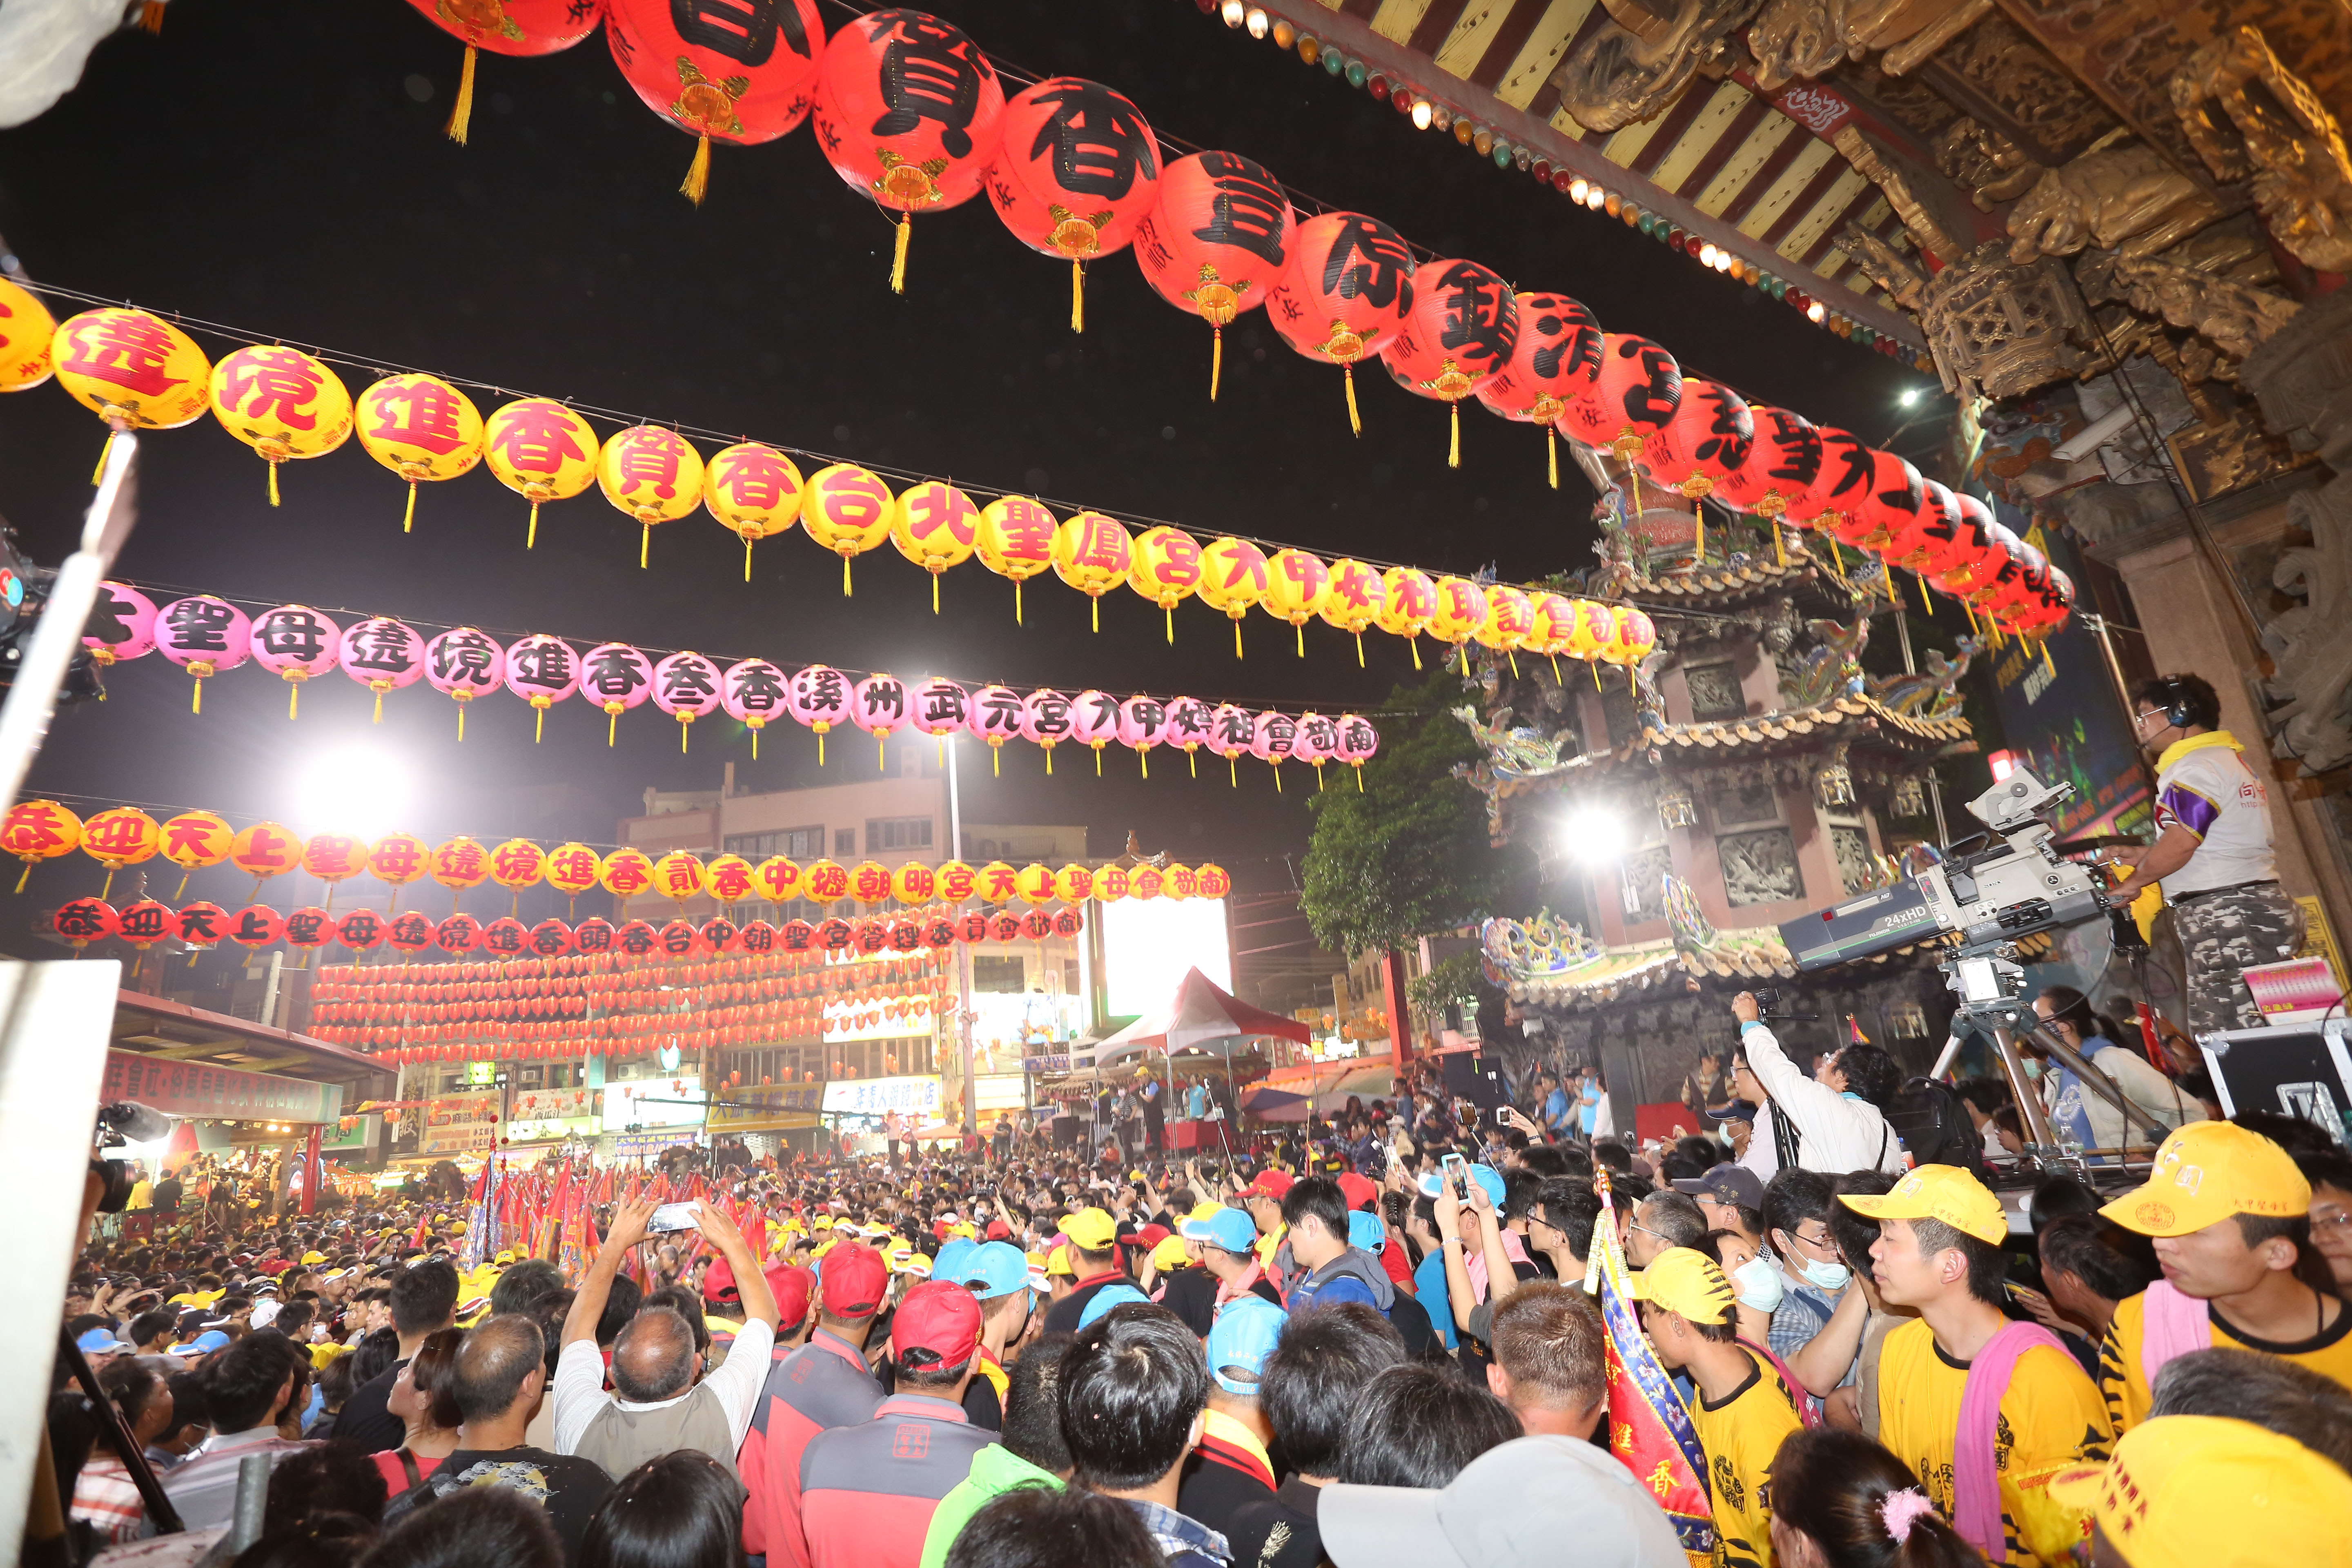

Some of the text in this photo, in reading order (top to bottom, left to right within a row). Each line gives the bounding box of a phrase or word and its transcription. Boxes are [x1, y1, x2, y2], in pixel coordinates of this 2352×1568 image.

[218, 347, 323, 430] 境
[369, 375, 467, 455] 進
[491, 402, 585, 474] 香
[717, 446, 797, 509] 香
[822, 469, 886, 528] 台
[911, 486, 976, 546] 北
[1000, 499, 1055, 561] 聖
[1072, 516, 1131, 572] 鳳
[1152, 531, 1201, 586] 宮
[1220, 545, 1268, 590] 大
[1283, 554, 1328, 603] 甲
[1393, 571, 1439, 618] 祖
[167, 600, 234, 650] 聖
[255, 611, 326, 661] 母
[434, 632, 492, 684] 境
[515, 640, 572, 688] 進
[588, 650, 646, 695] 香
[732, 665, 785, 710] 香
[799, 670, 842, 712] 溪
[865, 682, 902, 719] 州
[924, 686, 964, 722] 武
[982, 693, 1023, 731] 元
[1032, 694, 1072, 733] 宮
[1091, 695, 1120, 732] 大
[1132, 703, 1165, 737] 甲
[1219, 711, 1255, 744] 祖
[1263, 717, 1298, 752] 會
[1, 805, 63, 850] 恭
[84, 814, 147, 855] 迎
[167, 818, 218, 856] 天
[236, 829, 285, 866] 上
[306, 835, 353, 873] 聖
[370, 839, 421, 877] 母
[494, 845, 539, 881] 境
[552, 851, 593, 885] 進
[607, 855, 648, 889] 香
[713, 862, 751, 896] 香
[765, 861, 797, 895] 中
[858, 868, 891, 898] 朝
[904, 869, 933, 897] 明
[943, 867, 974, 899] 宮
[989, 870, 1018, 898] 天
[1029, 871, 1056, 897] 上
[1100, 871, 1130, 897] 母
[1134, 870, 1165, 898] 會
[1880, 892, 1891, 900] HD
[1983, 880, 2002, 889] SONY
[58, 903, 104, 935] 恭
[120, 908, 163, 937] 迎
[180, 910, 218, 938] 天
[234, 912, 269, 940] 上
[287, 914, 324, 943] 聖
[339, 915, 378, 945] 母
[439, 920, 471, 951] 境
[490, 926, 523, 951] 進
[533, 926, 565, 953] 香
[579, 926, 612, 949] 頭
[621, 926, 653, 953] 香
[665, 926, 692, 952] 台
[706, 922, 733, 946] 中
[743, 927, 771, 950] 朝
[826, 924, 851, 949] 宮
[1869, 928, 1890, 938] FUJINON
[1884, 906, 1926, 928] 24xHD
[1613, 1421, 1635, 1455] 進
[1646, 1459, 1683, 1497] 香
